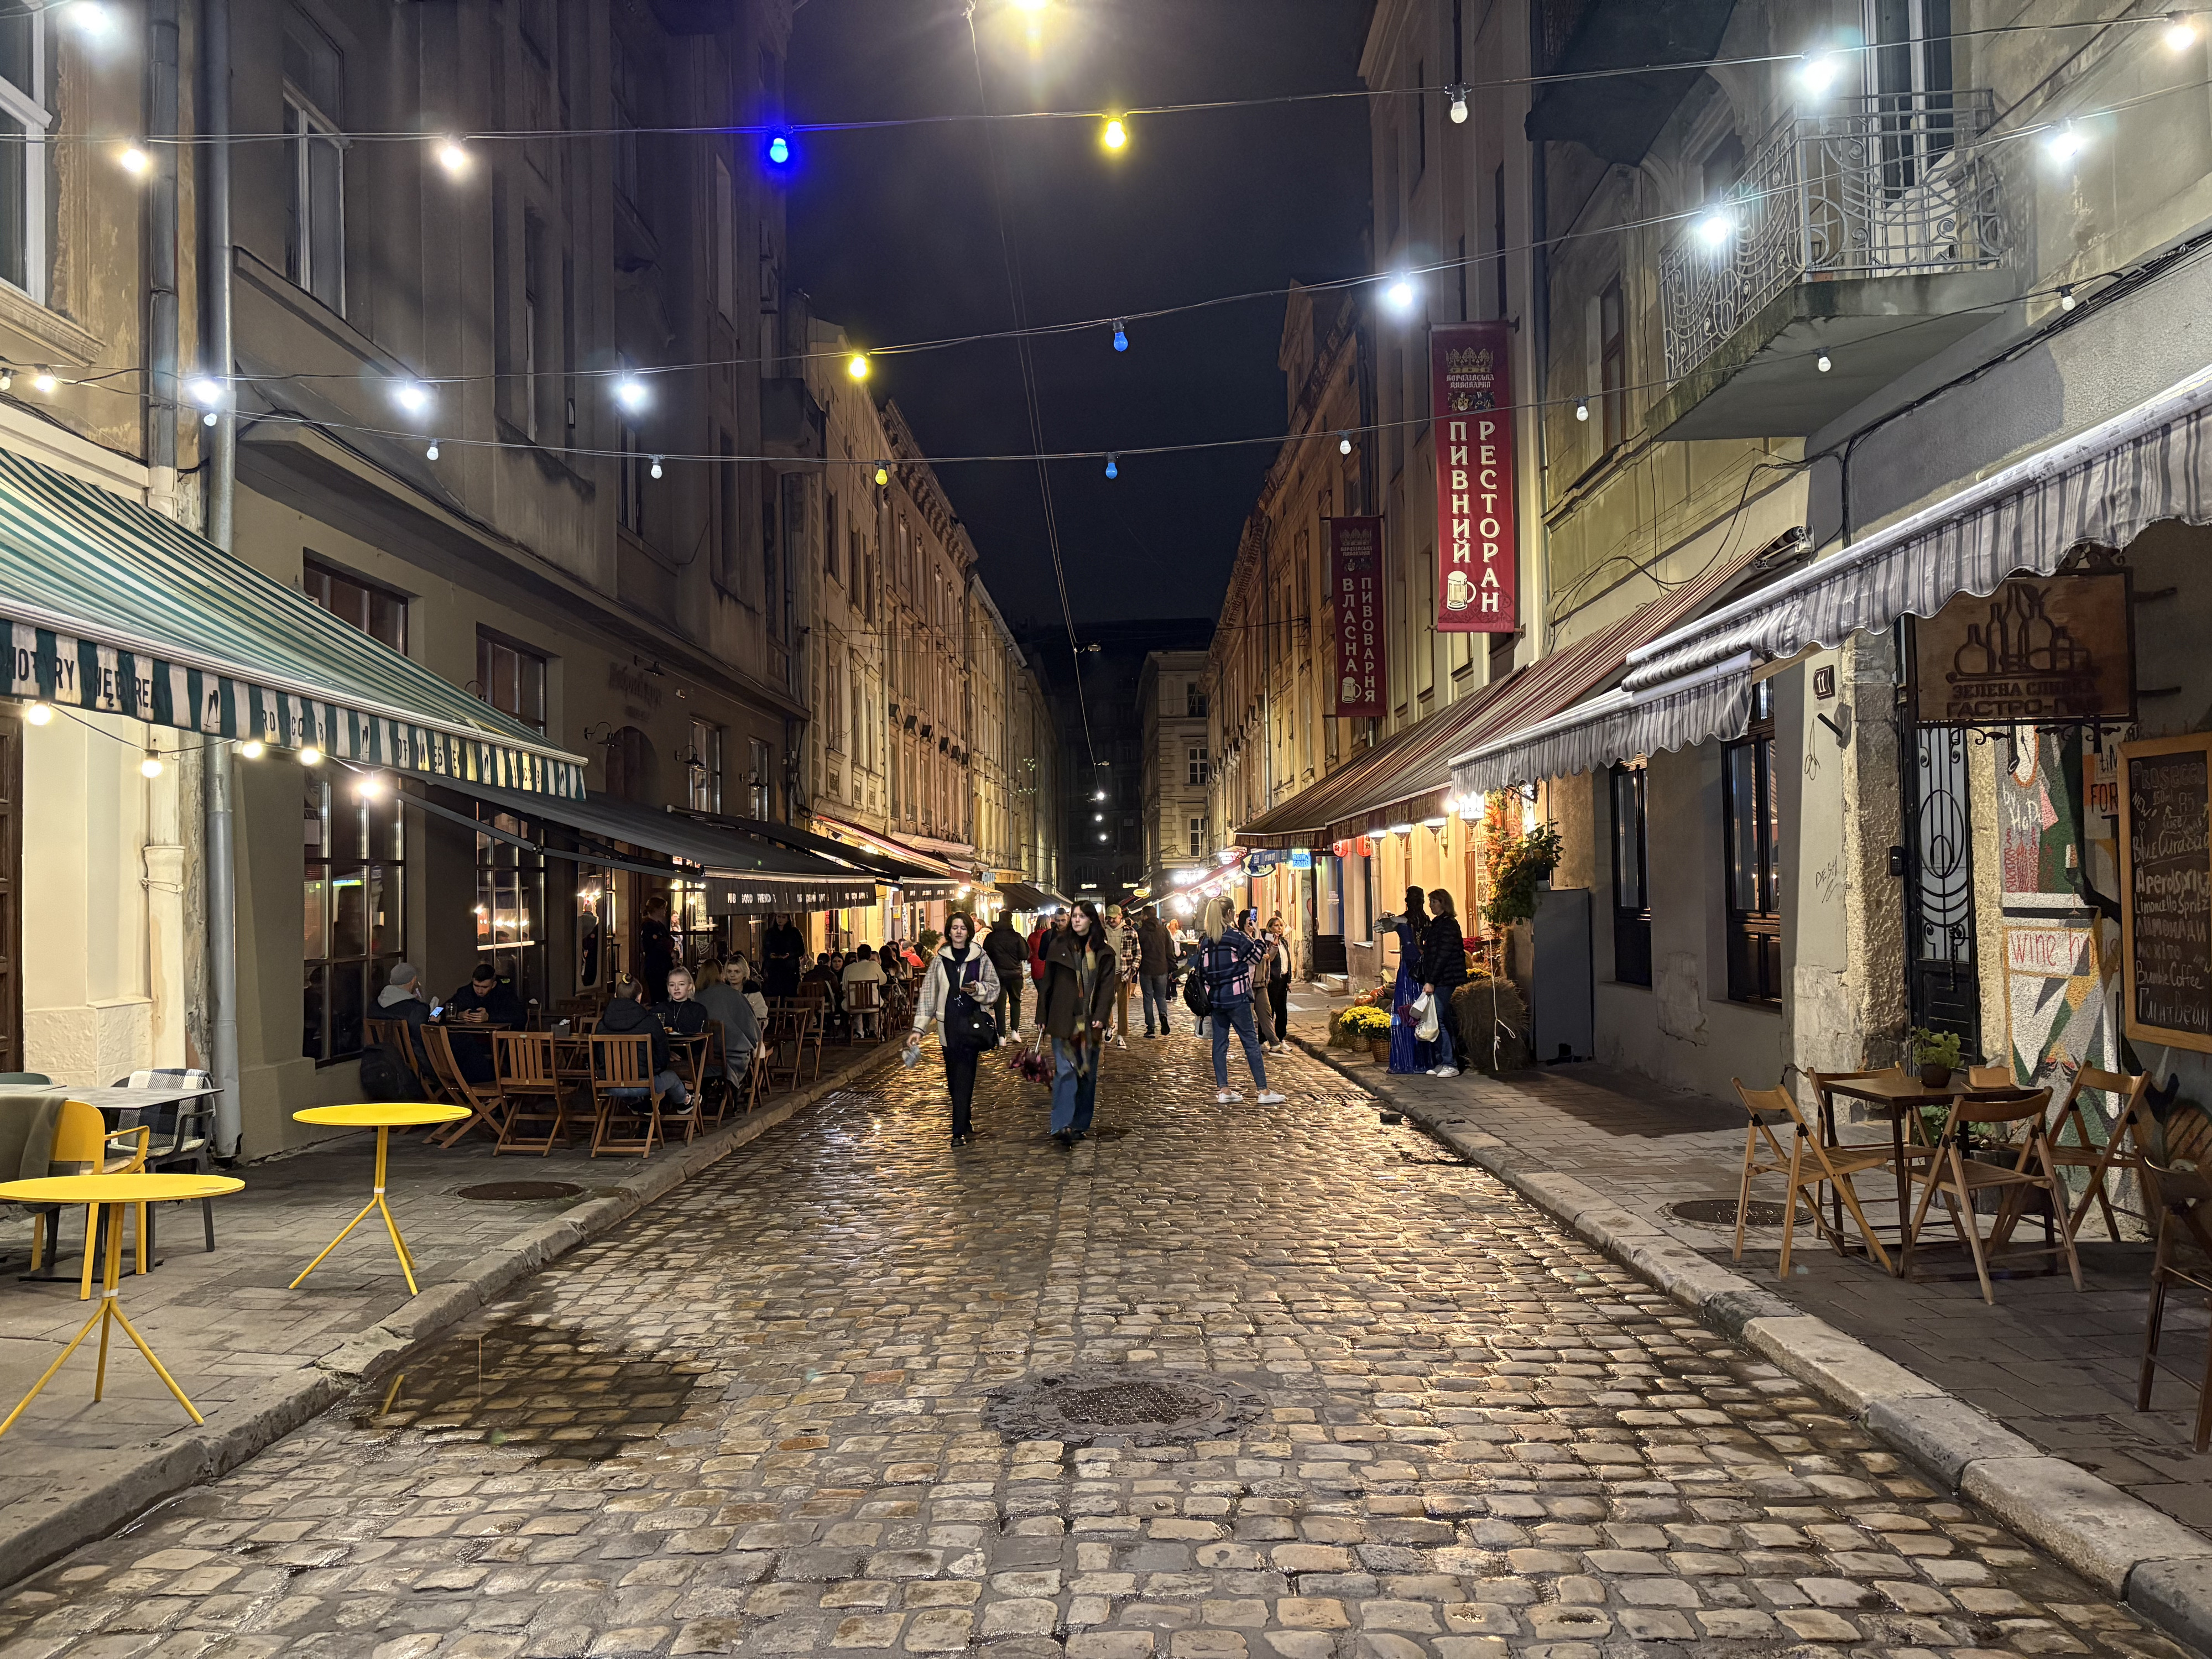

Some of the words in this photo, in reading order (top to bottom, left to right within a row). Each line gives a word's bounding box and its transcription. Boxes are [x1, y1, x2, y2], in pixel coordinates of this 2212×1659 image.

[1449, 421, 1471, 564] ПИВНИЙ
[1479, 421, 1499, 613] РЕСТОРАН
[1342, 578, 1358, 672] ВЛАСНА
[1361, 577, 1376, 702] ПИВОВАРНЯ
[1817, 672, 1827, 693] 11
[1952, 682, 2022, 699] ЗЕЛЕНА
[2010, 933, 2057, 967] wine
